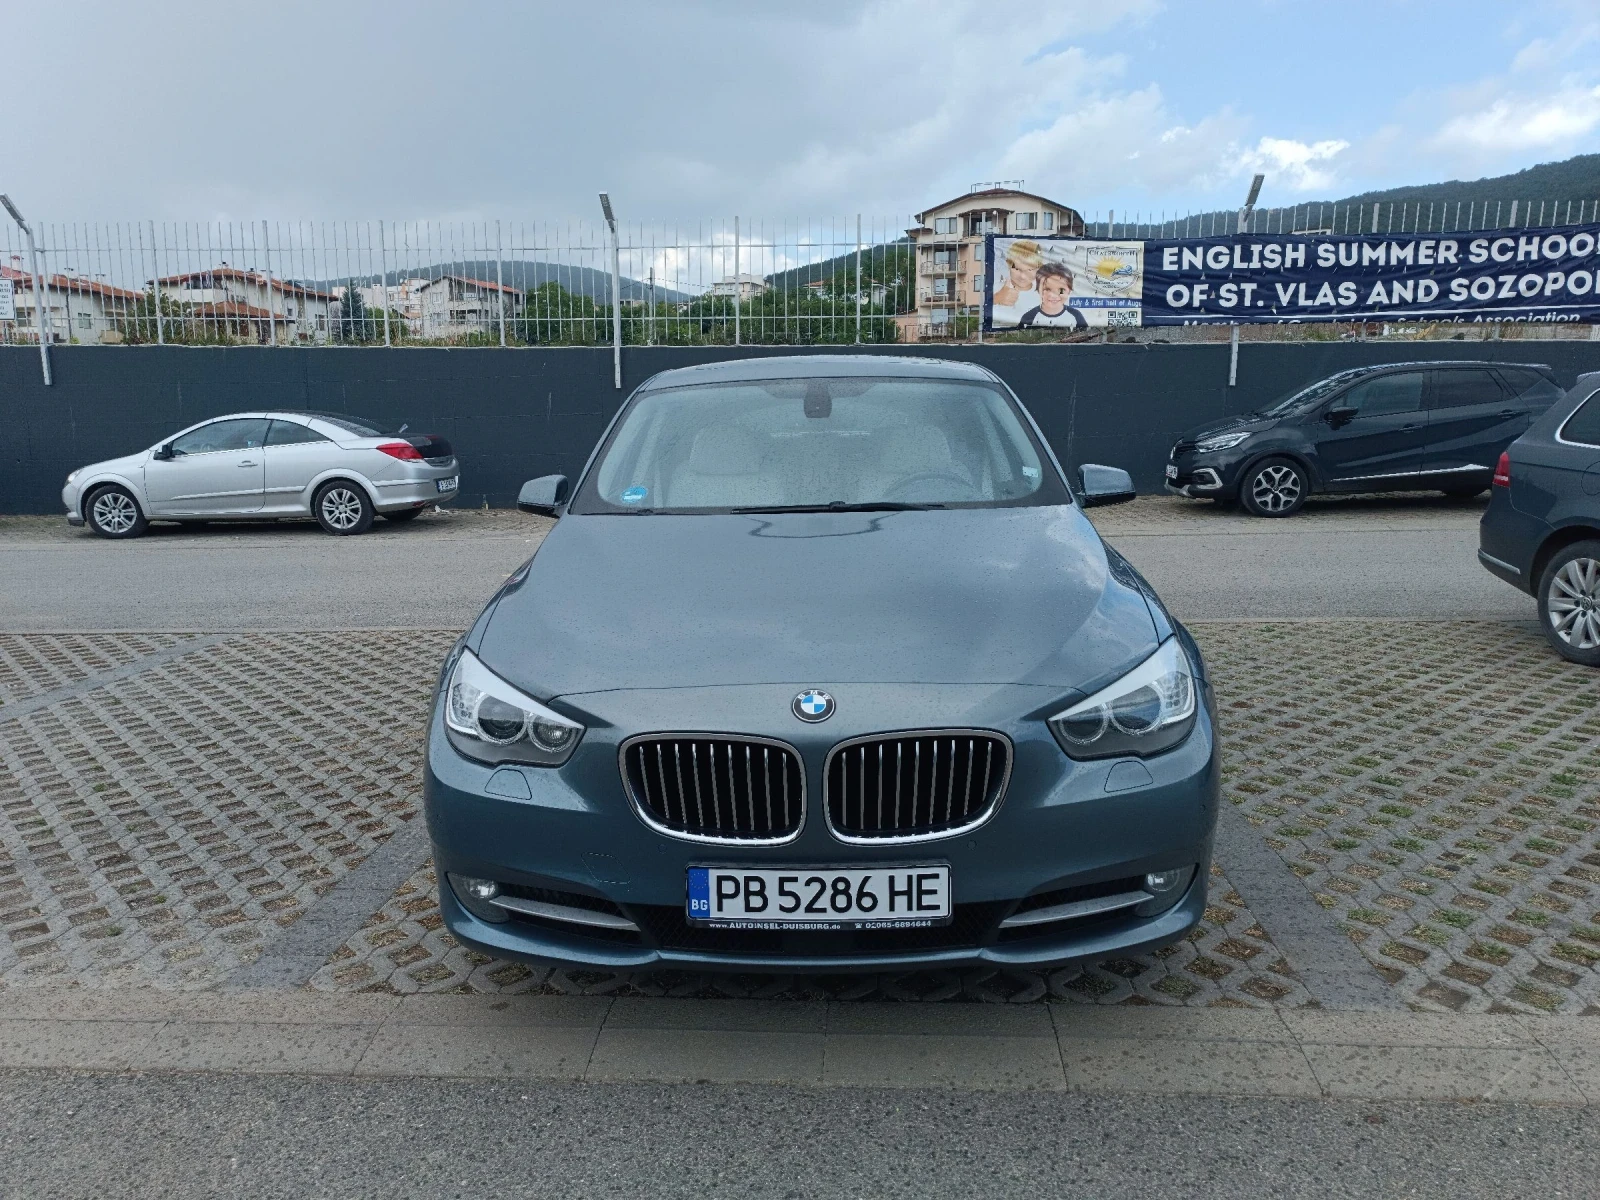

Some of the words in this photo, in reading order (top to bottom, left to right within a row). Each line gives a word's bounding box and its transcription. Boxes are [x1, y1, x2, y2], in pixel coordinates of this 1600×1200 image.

[1163, 243, 1305, 270] ENGLISH
[1317, 240, 1458, 268] SUMMER
[1468, 232, 1600, 263] SCHOO
[1070, 299, 1082, 307] July
[1166, 283, 1209, 308] OF
[1218, 282, 1264, 307] ST.
[1275, 281, 1357, 307] VLAS
[1366, 279, 1440, 305] AND
[797, 690, 831, 700] BMW
[717, 875, 768, 912] PB
[779, 875, 878, 913] 5286
[888, 873, 940, 911] HE
[691, 899, 709, 910] BG
